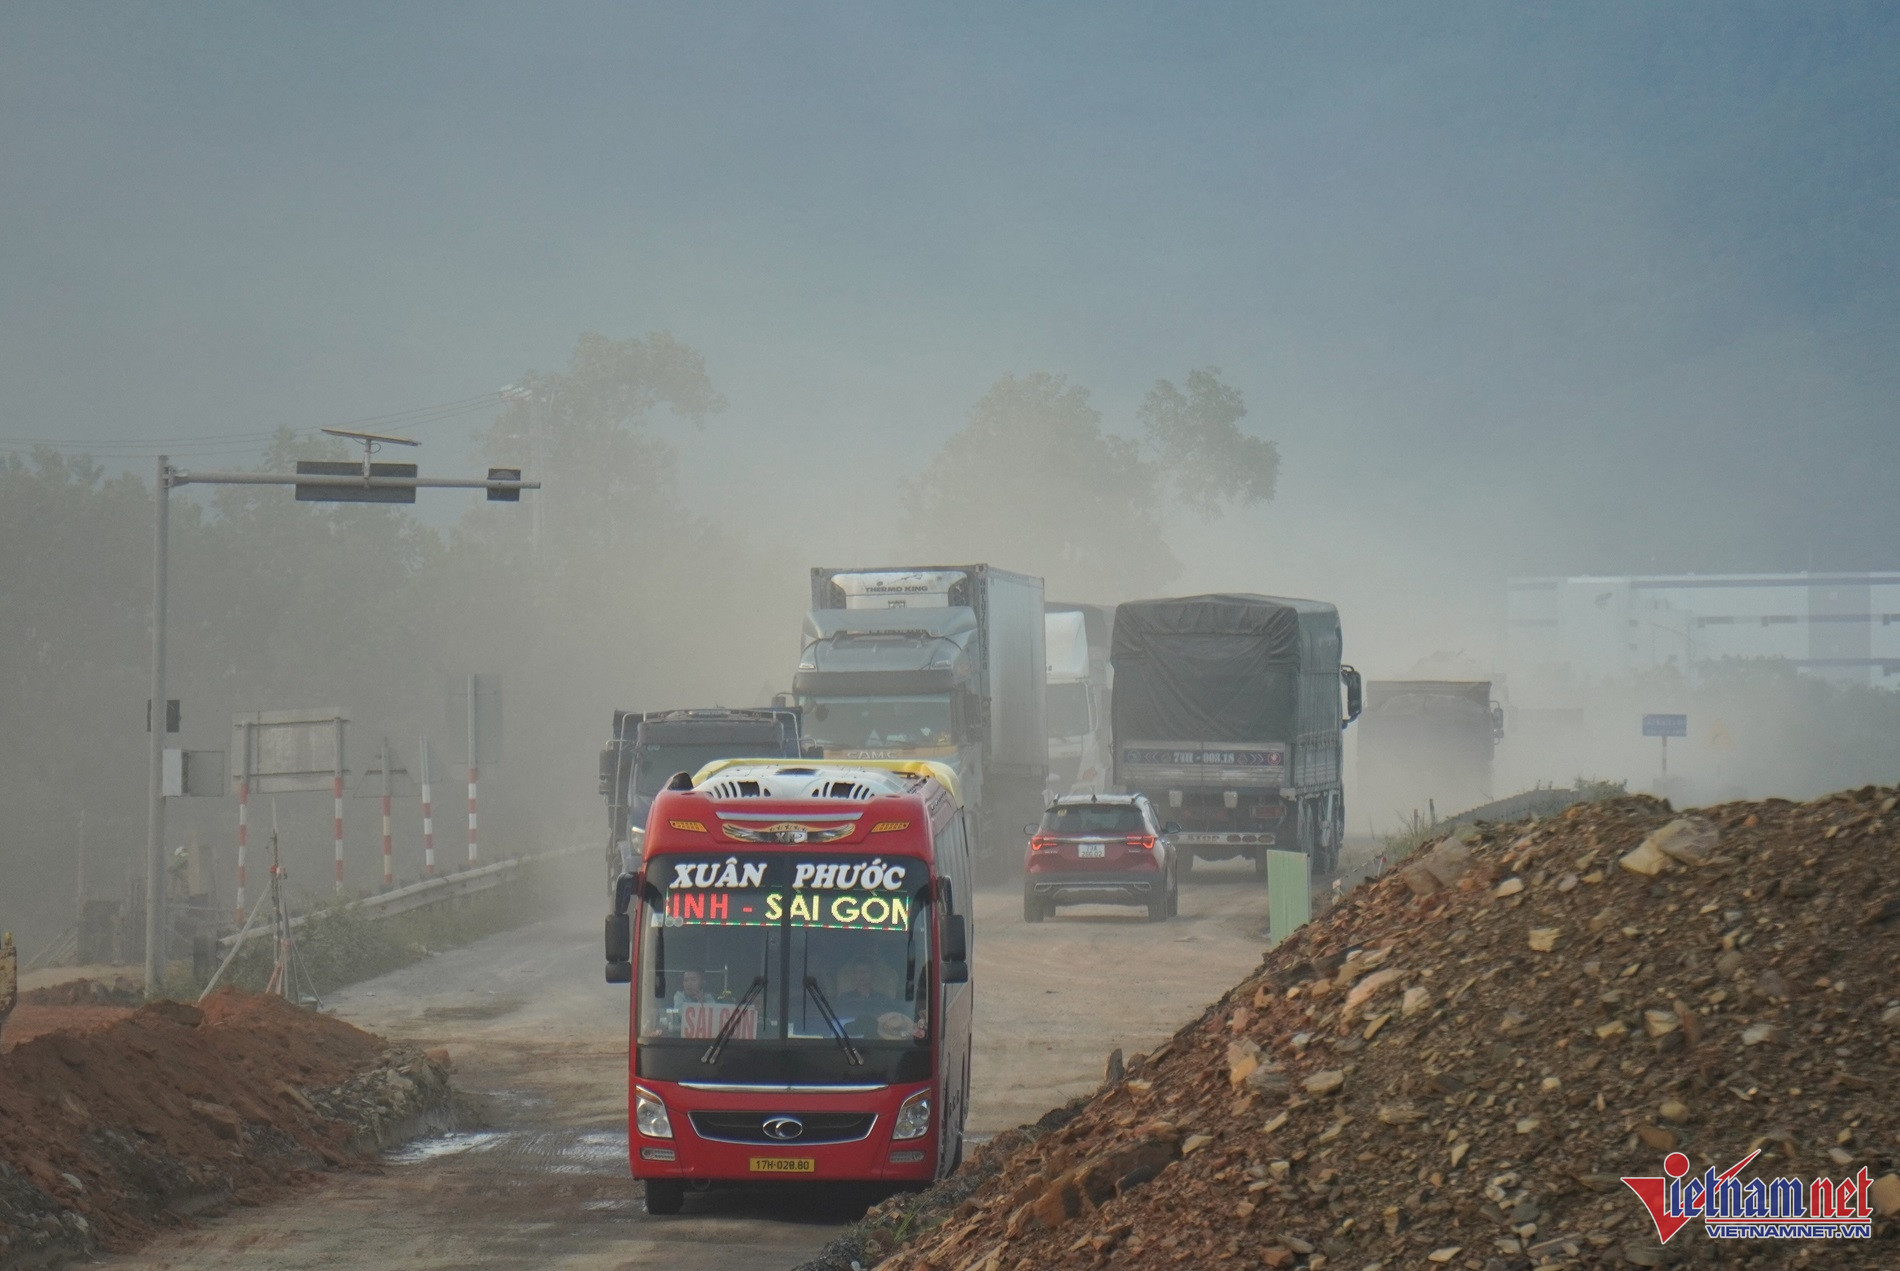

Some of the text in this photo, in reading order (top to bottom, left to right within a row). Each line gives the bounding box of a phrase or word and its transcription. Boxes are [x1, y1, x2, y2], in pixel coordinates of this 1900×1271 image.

[846, 751, 898, 760] CAMC
[669, 857, 906, 891] XUÂN PHƯỚC
[667, 893, 729, 919] INH
[756, 1160, 809, 1170] 17H-028.80
